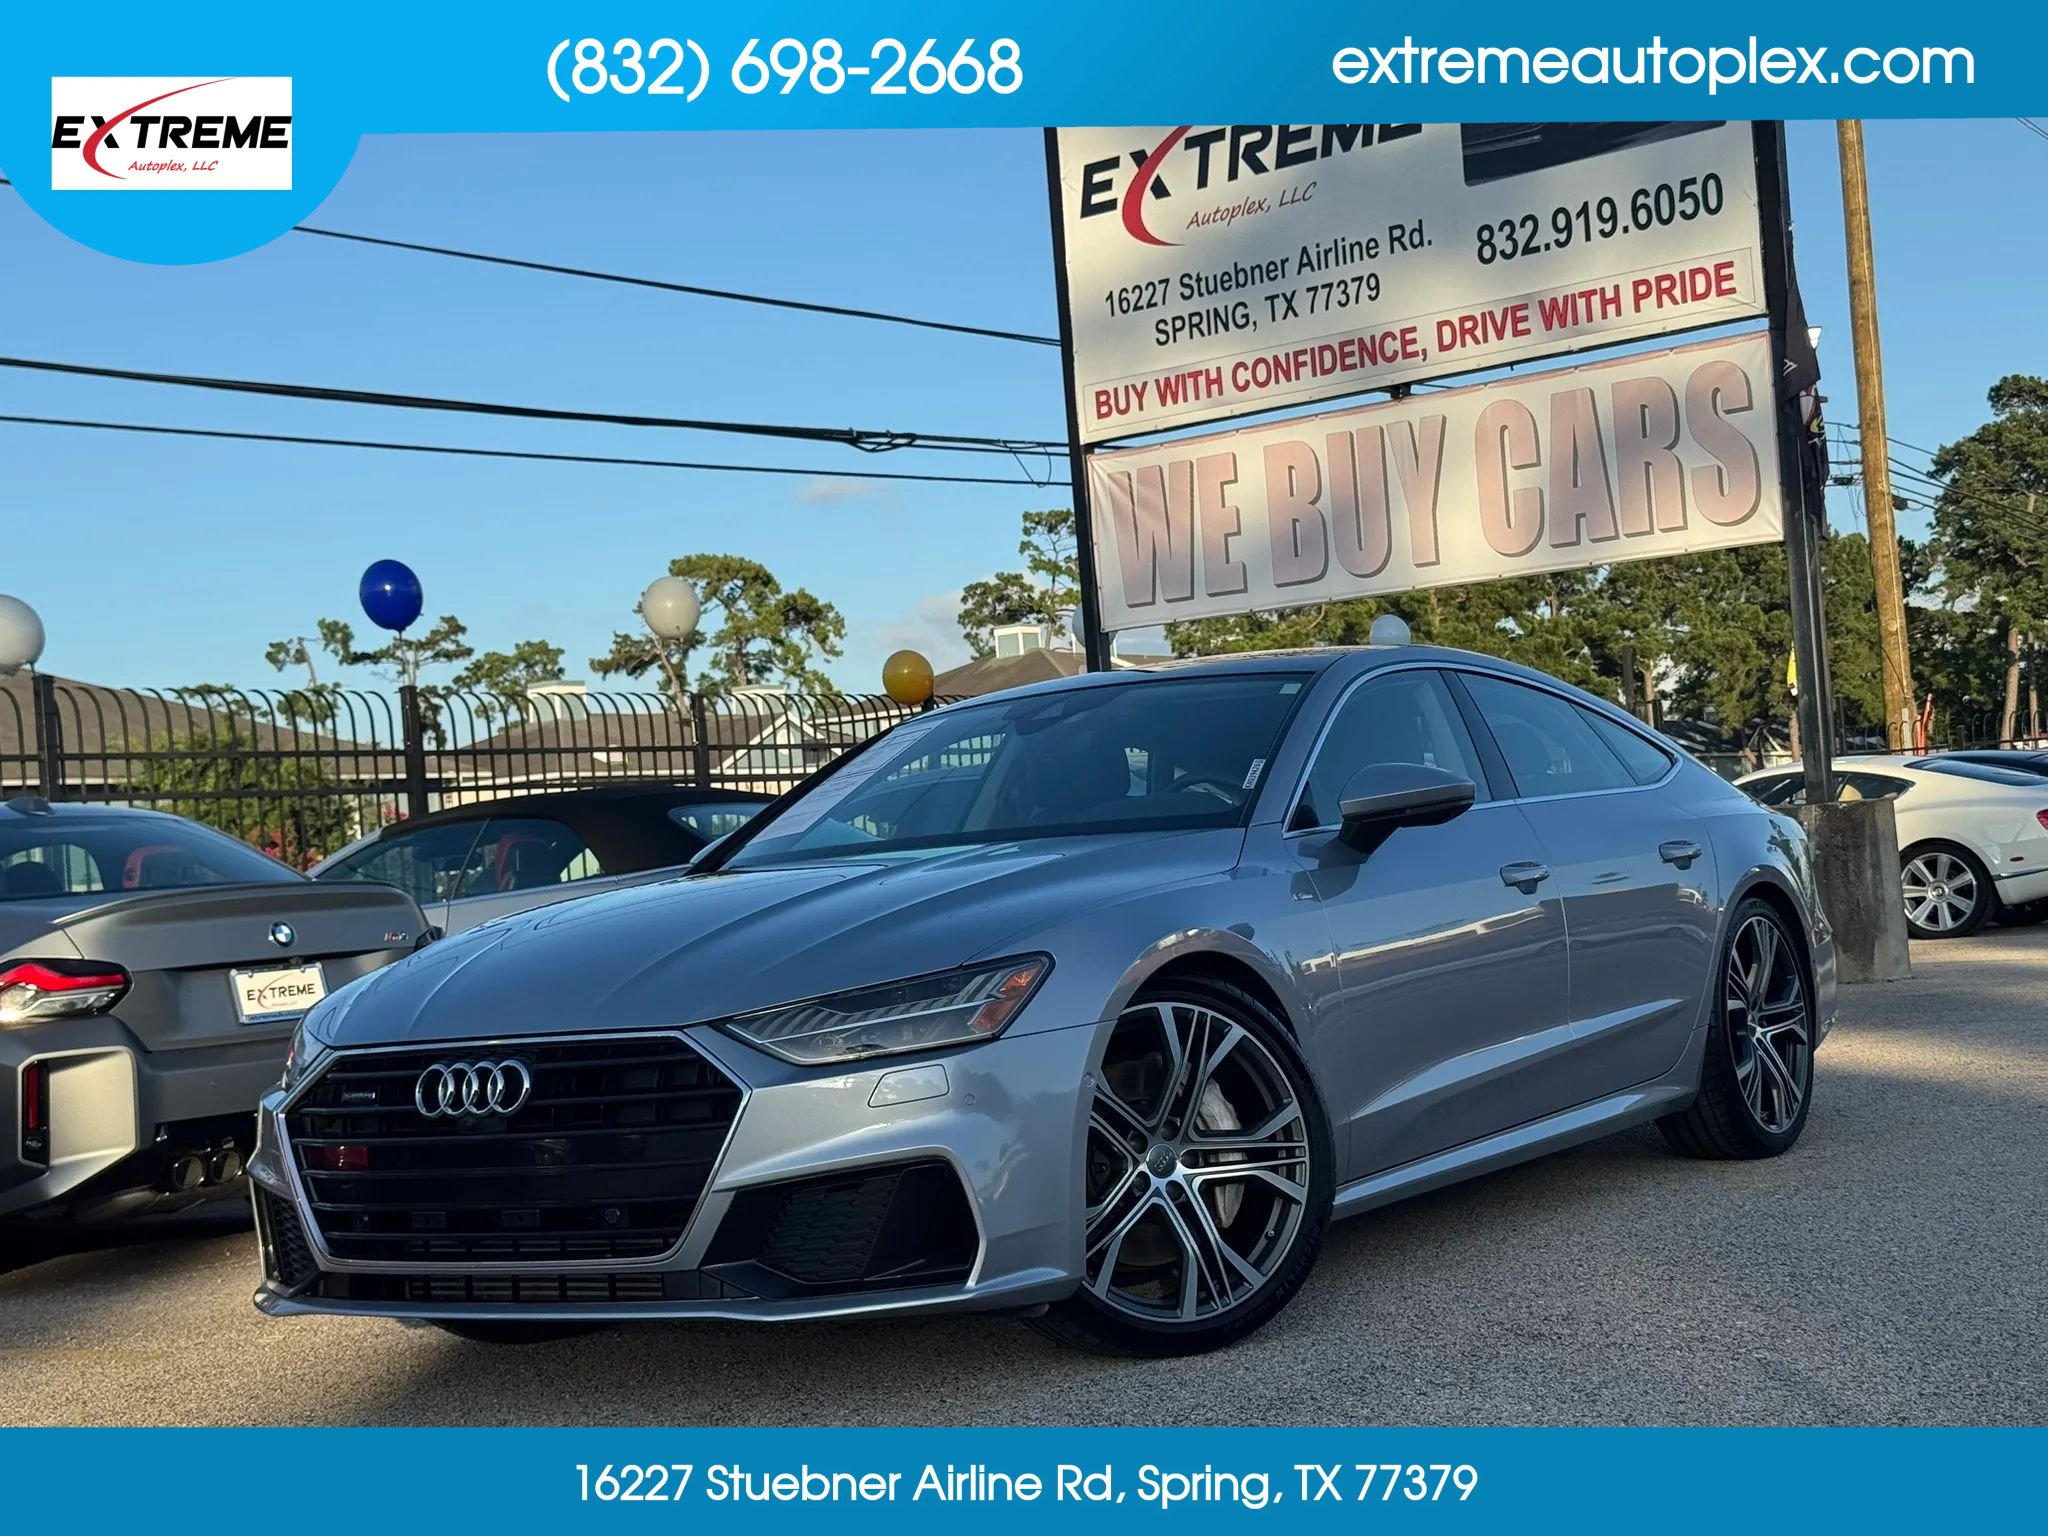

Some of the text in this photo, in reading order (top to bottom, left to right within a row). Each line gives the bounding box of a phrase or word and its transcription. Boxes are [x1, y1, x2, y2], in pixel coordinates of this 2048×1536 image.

[1186, 181, 1317, 231] Autoplex, LLC
[1476, 172, 1724, 265] 832.919.6050
[1105, 219, 1433, 317] 16227 Stuebner Airline Rd.
[1154, 272, 1381, 346] SPRING, TX 77379
[1095, 261, 1737, 420] BUY WITH CONFIDENCE, DRIVE WITH PRIDE
[1108, 360, 1761, 608] WE BUY CARS
[247, 983, 316, 1001] EXTREME
